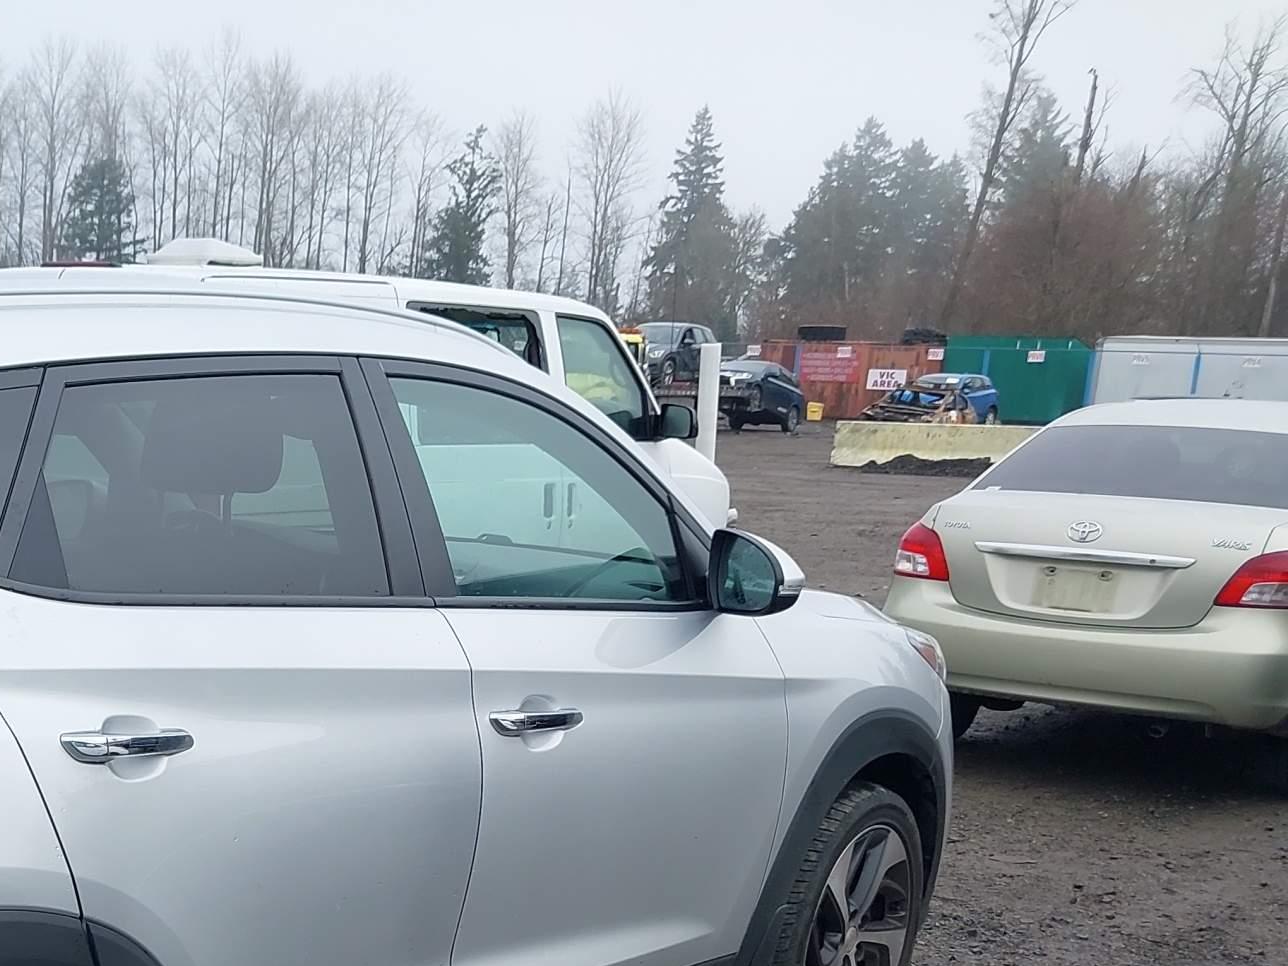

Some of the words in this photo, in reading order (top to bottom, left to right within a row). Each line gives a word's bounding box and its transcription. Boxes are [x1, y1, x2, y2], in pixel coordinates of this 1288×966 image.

[879, 371, 896, 379] VIC
[872, 380, 899, 388] AREA
[944, 520, 971, 530] TOYOTA
[1211, 537, 1253, 551] YARIS
